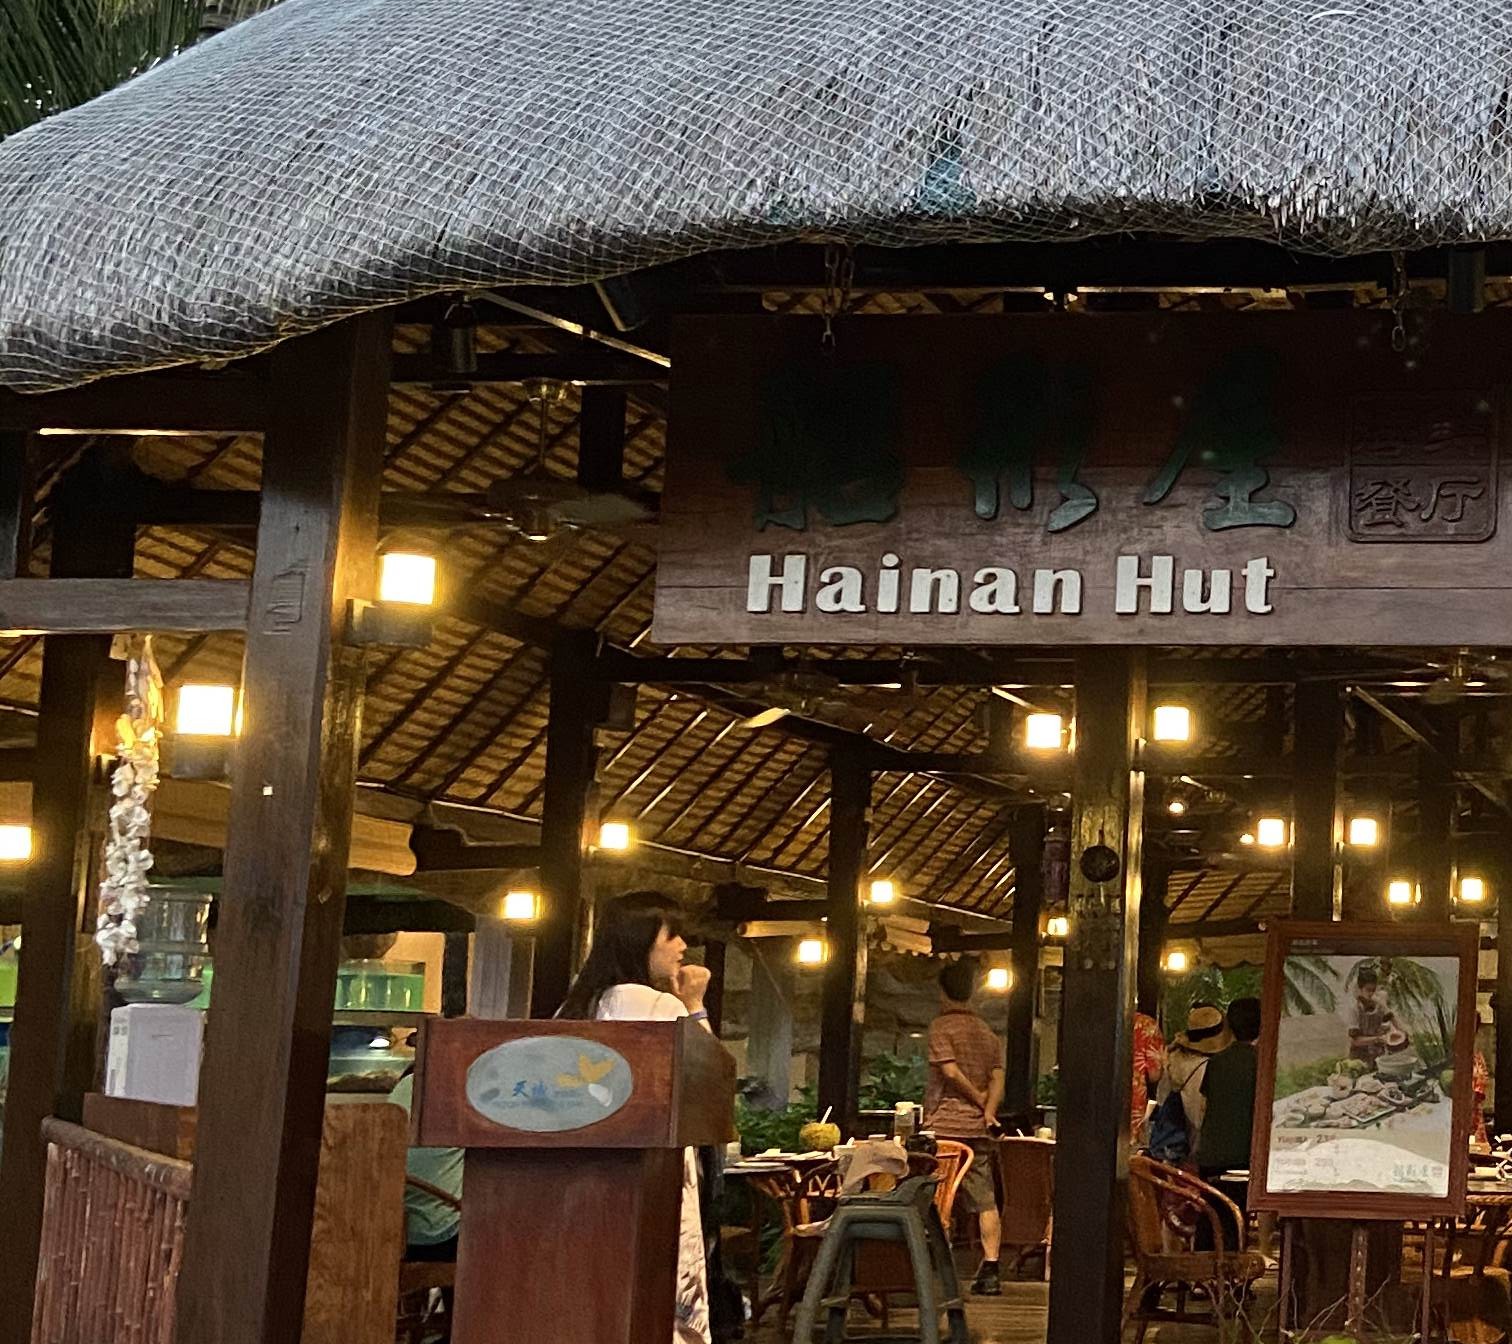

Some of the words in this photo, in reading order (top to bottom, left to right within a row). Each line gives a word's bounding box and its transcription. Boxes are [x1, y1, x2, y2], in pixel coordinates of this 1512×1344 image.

[1353, 476, 1488, 529] 餐厅
[745, 552, 1083, 615] Hainan
[1114, 554, 1276, 615] Hut
